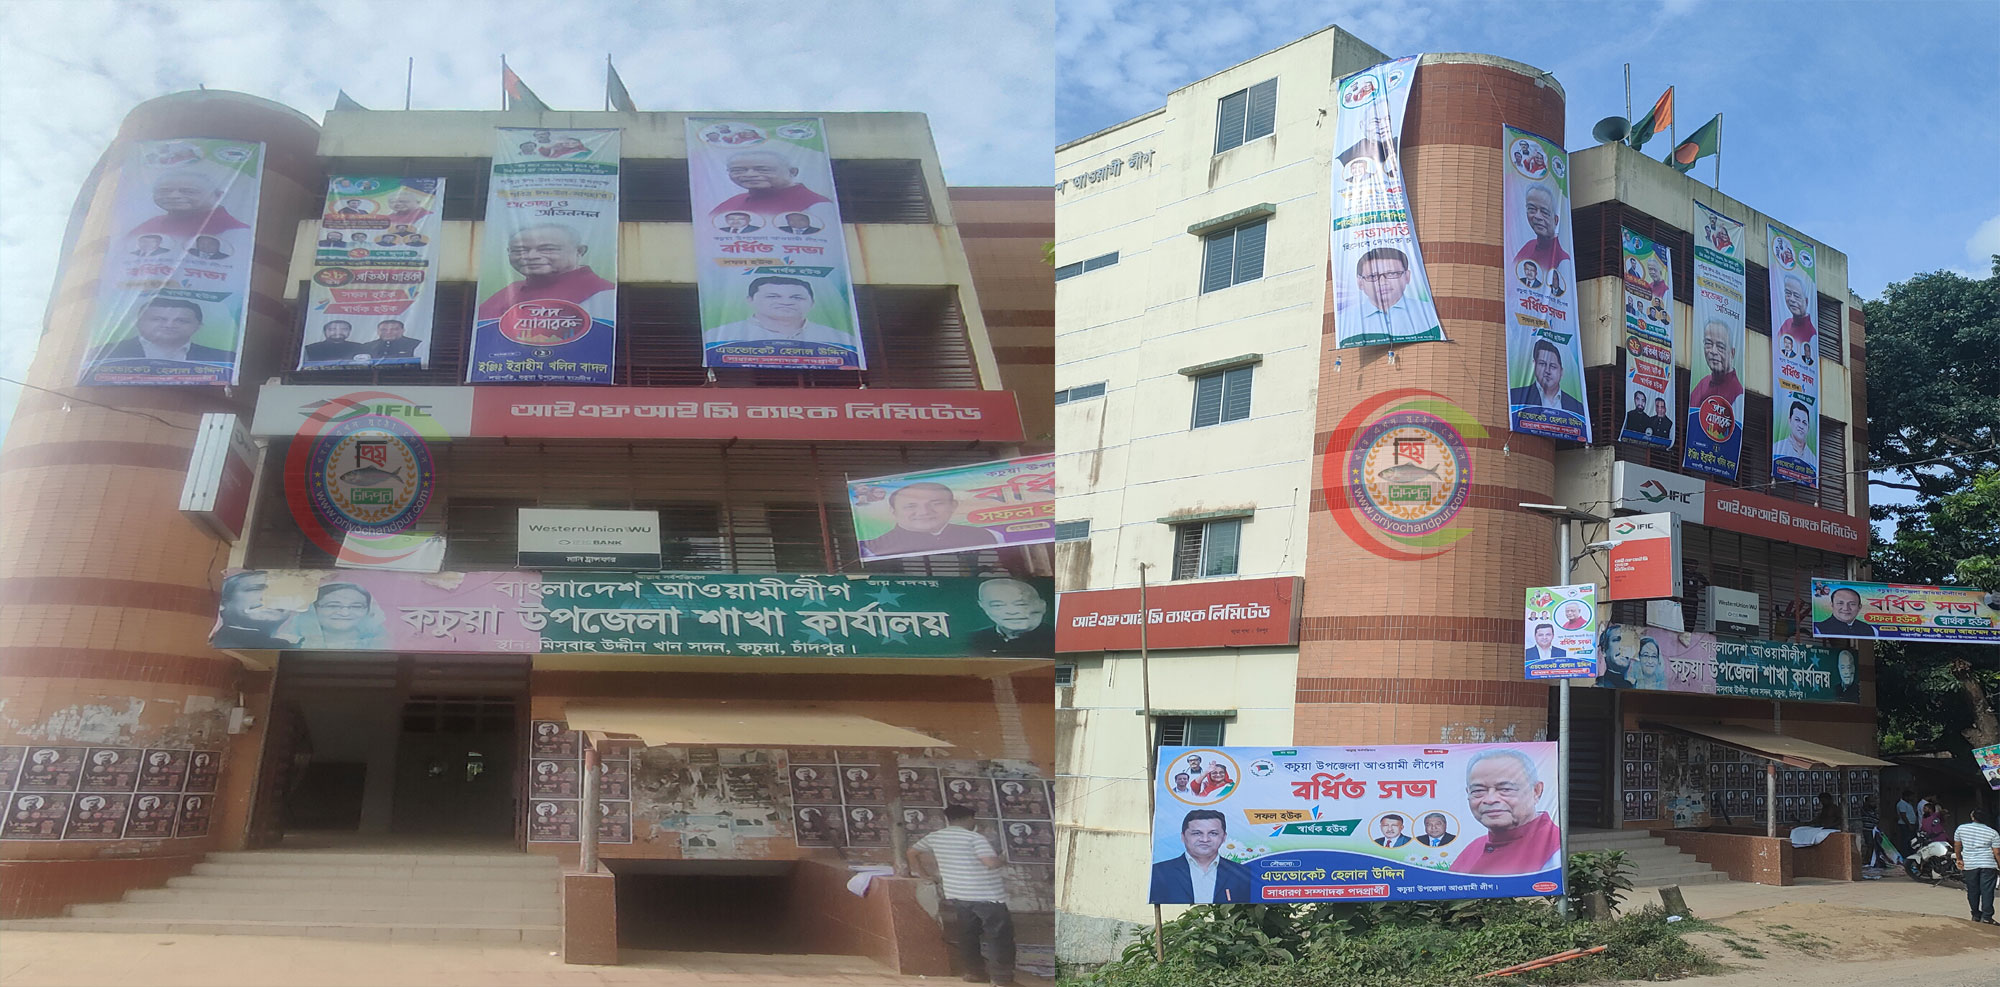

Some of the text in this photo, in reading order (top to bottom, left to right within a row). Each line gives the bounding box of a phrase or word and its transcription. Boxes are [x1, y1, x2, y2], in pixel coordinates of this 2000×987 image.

[1128, 149, 1156, 171] লীগ
[534, 206, 600, 219] অভিনন্দন
[1354, 222, 1410, 239] সভাপতি
[720, 241, 824, 255] বর্ধিত সভা
[580, 362, 608, 374] বাদল
[376, 404, 433, 417] IFIC
[747, 404, 838, 420] ব্যাংক
[845, 402, 982, 420] লিমিটেড
[1669, 489, 1690, 504] IFIC
[977, 505, 1034, 521] সফল
[1637, 522, 1654, 530] IFIC
[1820, 519, 1858, 541] লিমিটেড
[493, 579, 643, 599] বাংলাদেশ
[1866, 594, 1980, 615] বর্ধিত সভা
[400, 600, 951, 640] কচুয়া উপজেলা শাখা কার্যালয়
[1166, 609, 1206, 624] ব্যাংক
[1208, 602, 1271, 621] লিমিটেড
[1868, 614, 1894, 623] সফল
[1896, 615, 1918, 624] হউক
[1968, 618, 1991, 627] হউক
[600, 637, 646, 652] উদ্দীন
[653, 640, 682, 652] খান
[689, 642, 732, 656] সদন,
[1700, 639, 1748, 657] বাংলাদেশ
[1669, 656, 1831, 690] কচুয়া উপজেলা শাখা কার্যালয়
[1284, 757, 1444, 773] কচুয়া উপজেলা আওয়ামী লীগের
[1291, 772, 1437, 801] বর্ধিত সভা
[1254, 811, 1302, 821] সফল হউক
[1296, 823, 1348, 834] স্বার্থক হউক
[1261, 866, 1405, 882] এডভোকেট হেলাল উদ্দিন
[1267, 885, 1386, 898] সাধারণ সম্পাদক পদপ্রার্থী
[1416, 884, 1447, 893] উপজেলা
